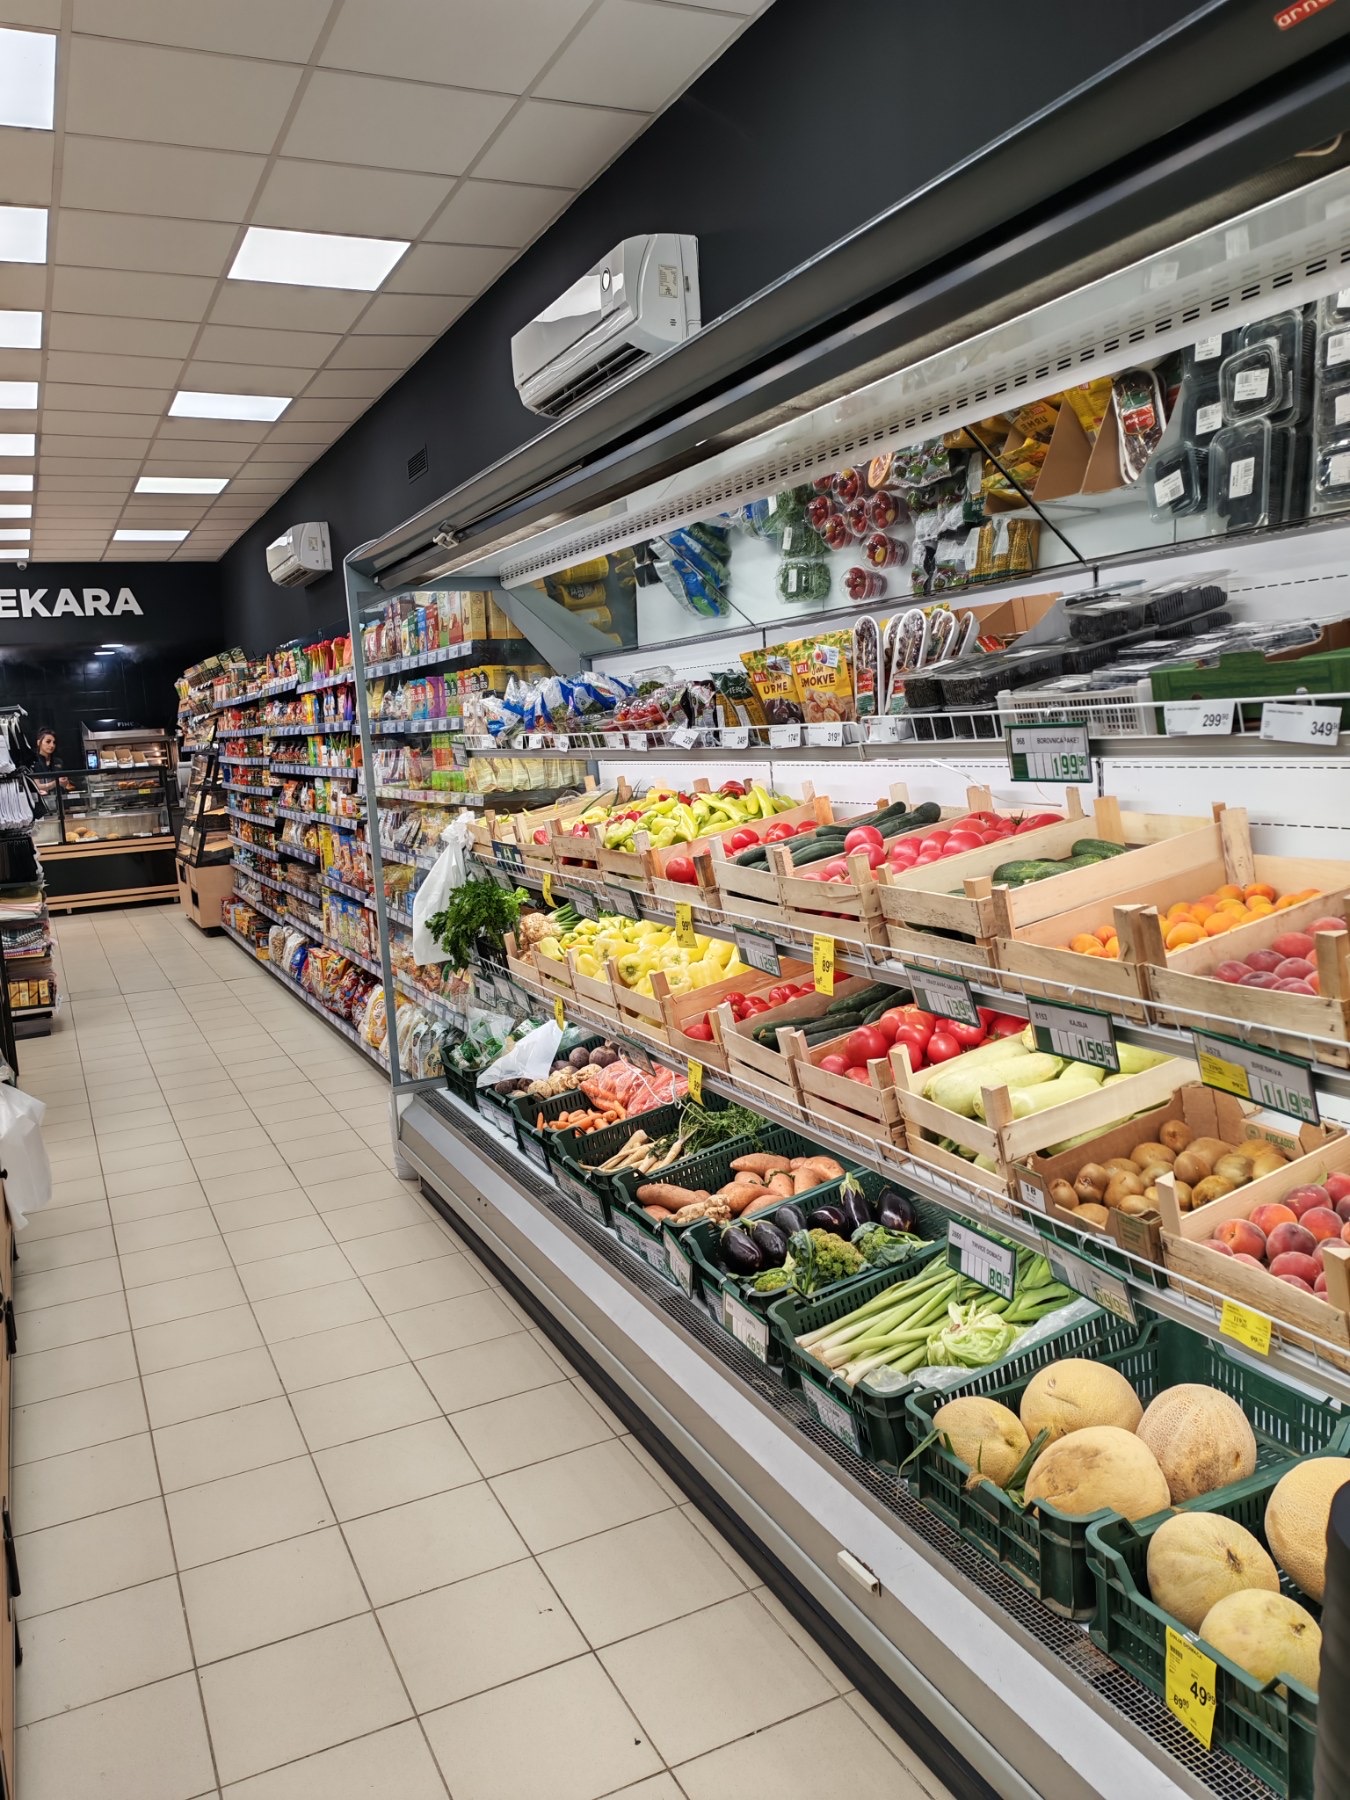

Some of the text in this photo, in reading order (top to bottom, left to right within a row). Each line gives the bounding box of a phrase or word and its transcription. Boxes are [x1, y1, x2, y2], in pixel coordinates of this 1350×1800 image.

[0, 587, 144, 618] EKARA
[763, 681, 788, 695] URME
[801, 673, 836, 688] SMOKVE
[1202, 713, 1222, 727] 299
[1310, 721, 1333, 737] 349
[1264, 1131, 1297, 1151] AVOCADOS
[1024, 1184, 1037, 1196] 18
[1189, 1681, 1207, 1706] 49
